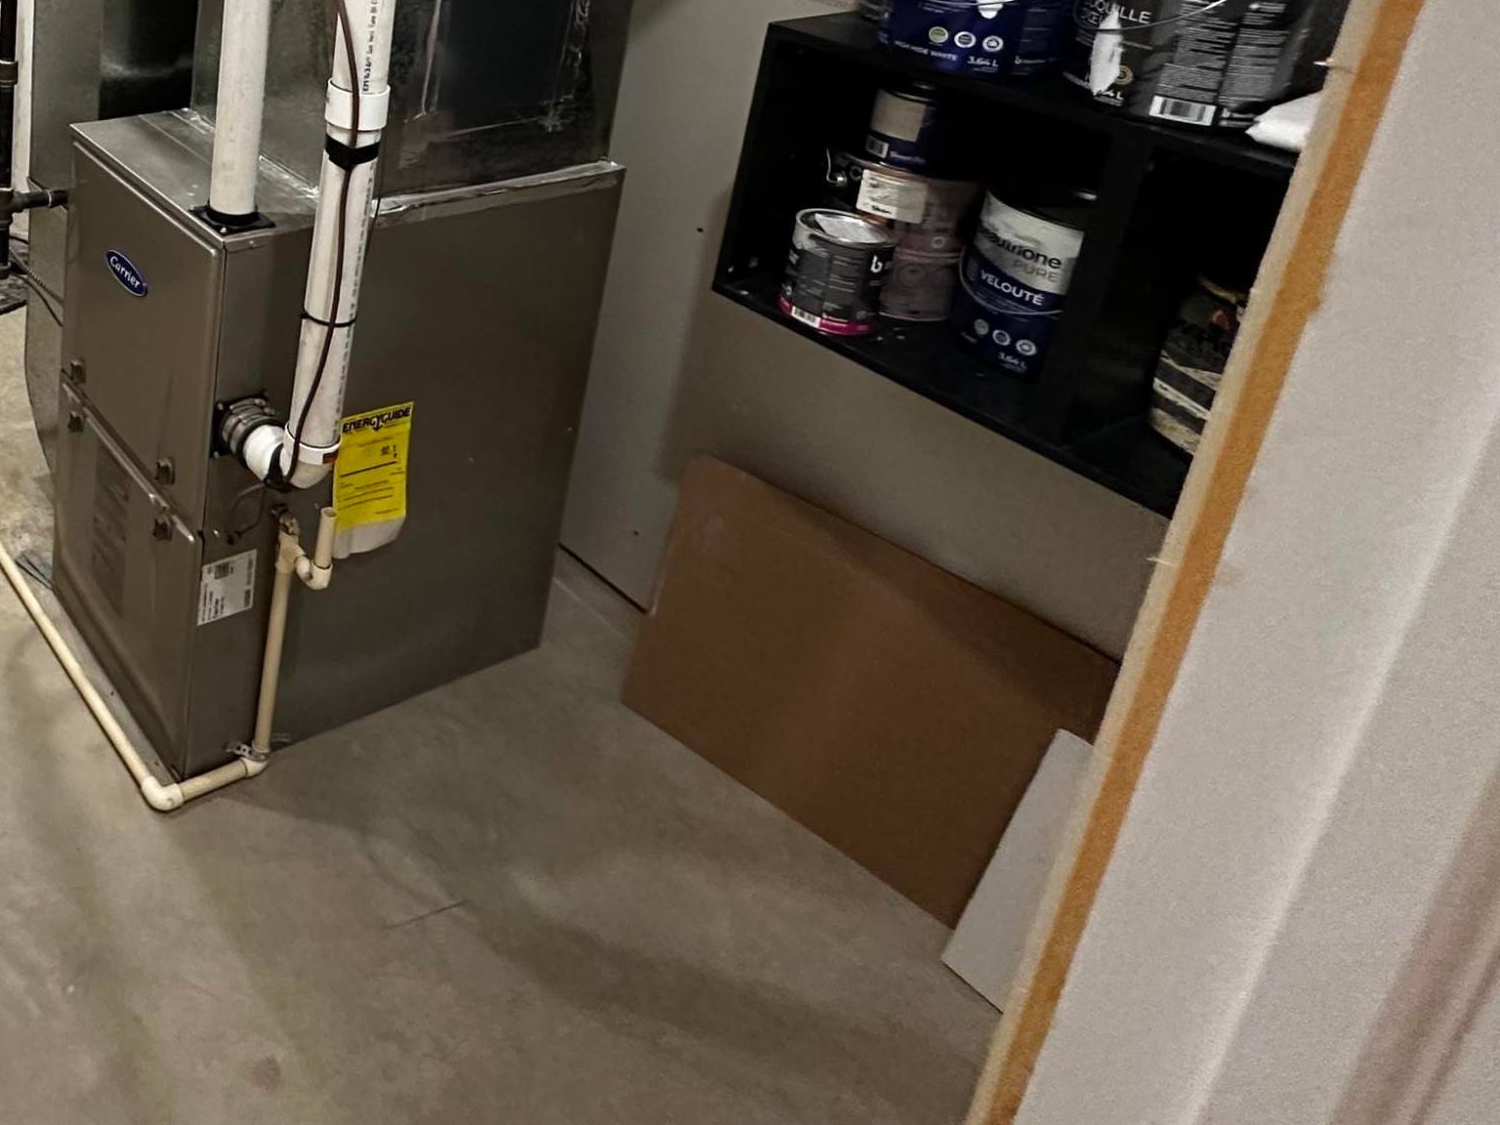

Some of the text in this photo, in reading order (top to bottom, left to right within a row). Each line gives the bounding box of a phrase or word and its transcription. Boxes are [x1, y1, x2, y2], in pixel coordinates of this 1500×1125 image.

[110, 255, 141, 289] Carrier
[980, 269, 1045, 306] VELOUTÉ
[1012, 259, 1058, 284] PURE
